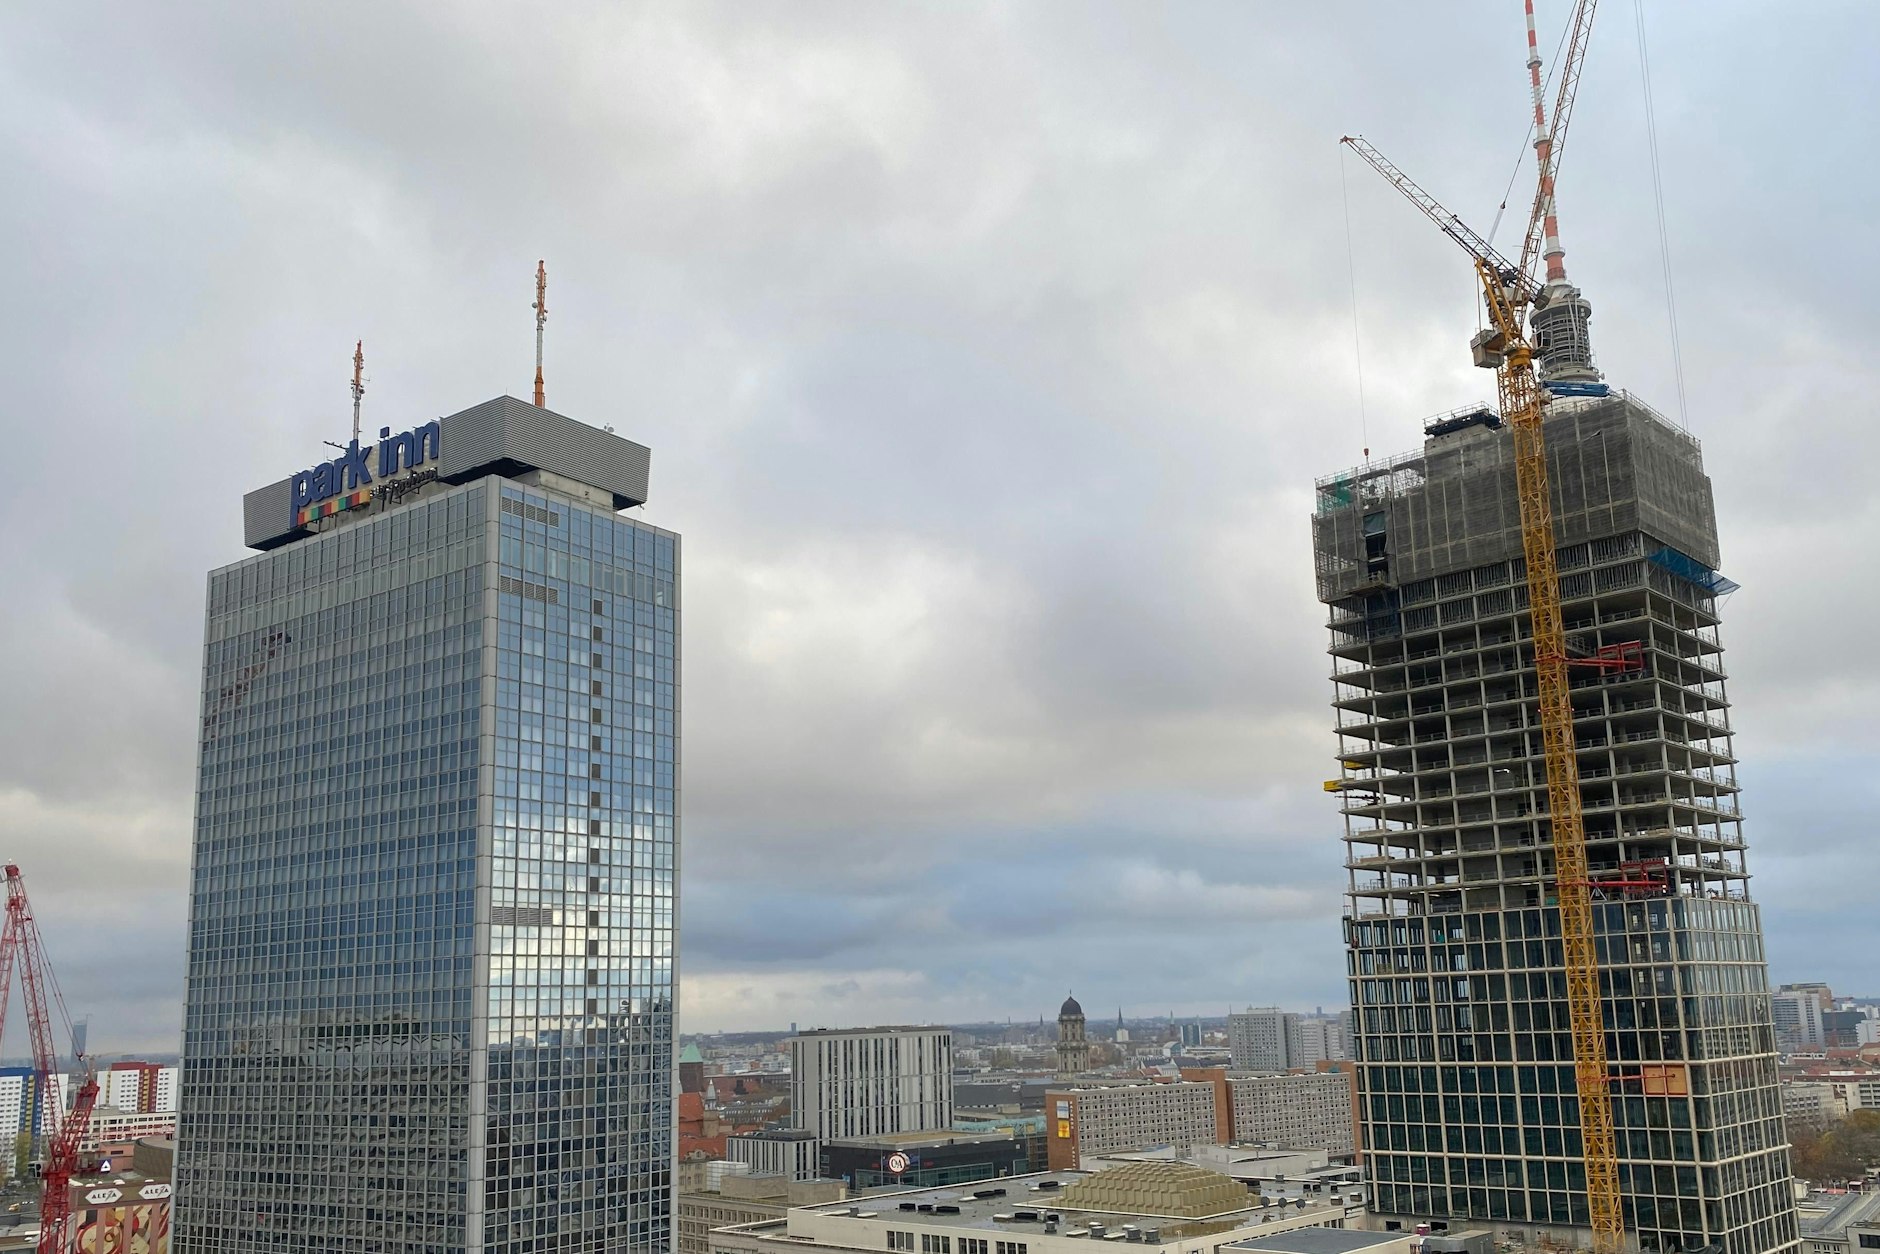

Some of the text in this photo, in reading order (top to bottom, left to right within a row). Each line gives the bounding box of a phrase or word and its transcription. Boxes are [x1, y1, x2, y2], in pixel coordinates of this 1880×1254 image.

[290, 421, 440, 528] park inn
[92, 1190, 117, 1201] ALEXA
[144, 1185, 169, 1196] ALEXA
